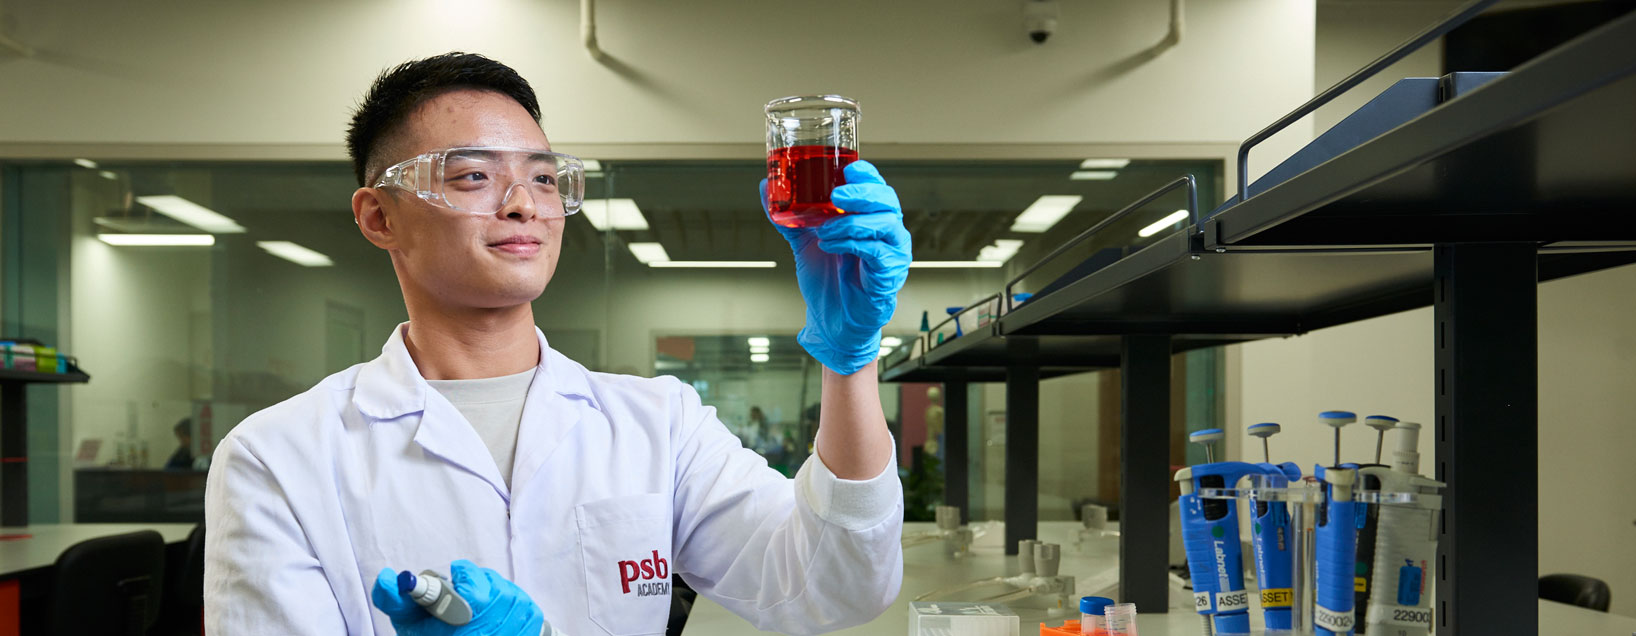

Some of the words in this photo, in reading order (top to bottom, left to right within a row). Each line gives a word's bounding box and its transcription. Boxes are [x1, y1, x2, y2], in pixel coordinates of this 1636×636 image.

[617, 550, 668, 594] psb
[1214, 541, 1229, 579] Labnet
[1261, 592, 1288, 603] SSET
[1393, 609, 1429, 623] 22900
